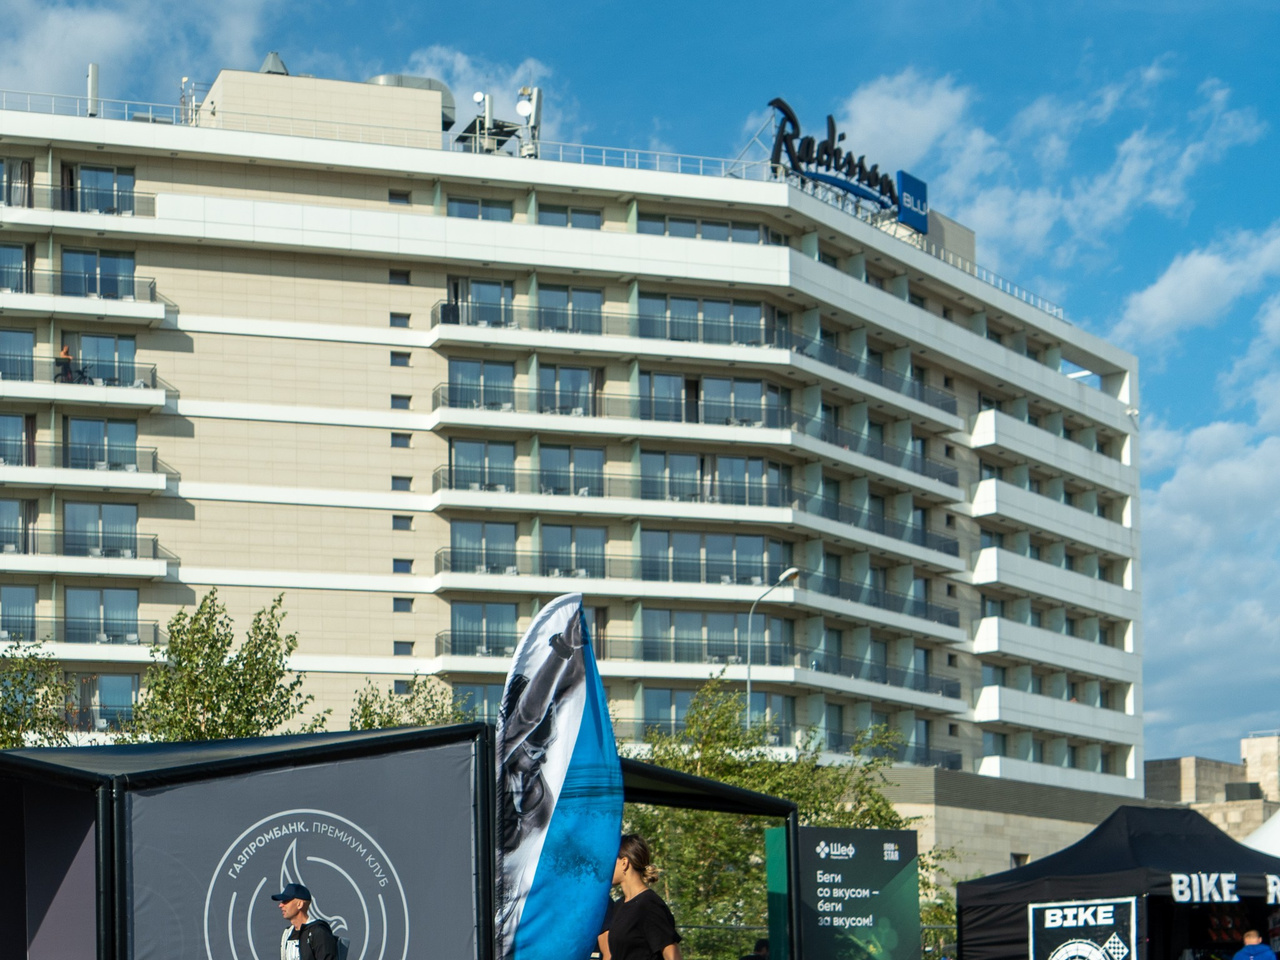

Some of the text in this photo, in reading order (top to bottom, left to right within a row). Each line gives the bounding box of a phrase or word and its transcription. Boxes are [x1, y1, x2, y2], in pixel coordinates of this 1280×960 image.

[768, 97, 898, 204] Radisson
[903, 192, 927, 216] BLU
[312, 822, 367, 857] ПРЕМИУМ
[365, 854, 389, 888] КЛУБ
[830, 843, 855, 858] Шеф
[816, 870, 841, 882] Беги
[817, 888, 830, 897] со
[833, 888, 869, 900] вкусом
[1170, 873, 1240, 902] BIKE
[817, 899, 842, 911] беги
[818, 914, 873, 928] за вкусом!
[1044, 905, 1115, 928] BIKE
